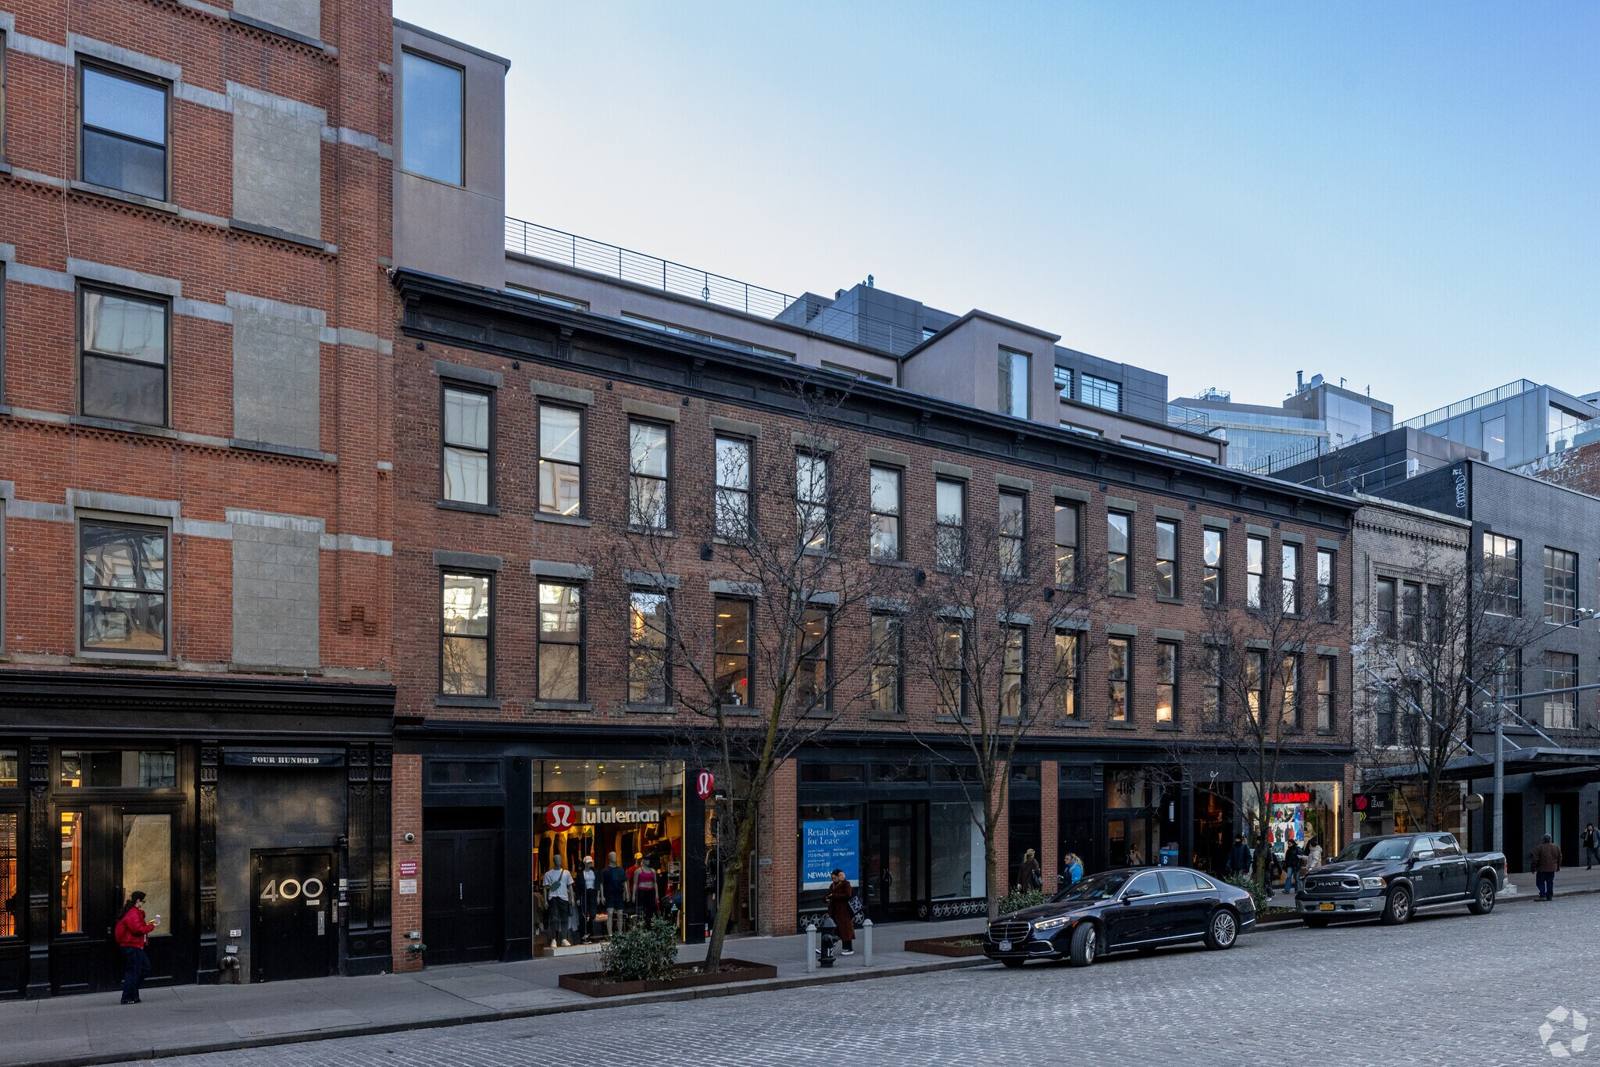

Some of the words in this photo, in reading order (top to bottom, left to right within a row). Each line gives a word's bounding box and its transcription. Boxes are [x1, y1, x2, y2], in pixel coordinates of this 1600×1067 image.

[251, 756, 276, 764] FOUR
[278, 756, 319, 764] HUNDRED
[581, 806, 660, 824] lululemon
[807, 828, 829, 837] Retail
[830, 828, 850, 838] Space
[807, 837, 818, 846] for
[819, 837, 841, 845] Lease
[807, 871, 832, 880] NEWMA
[260, 877, 324, 902] 400
